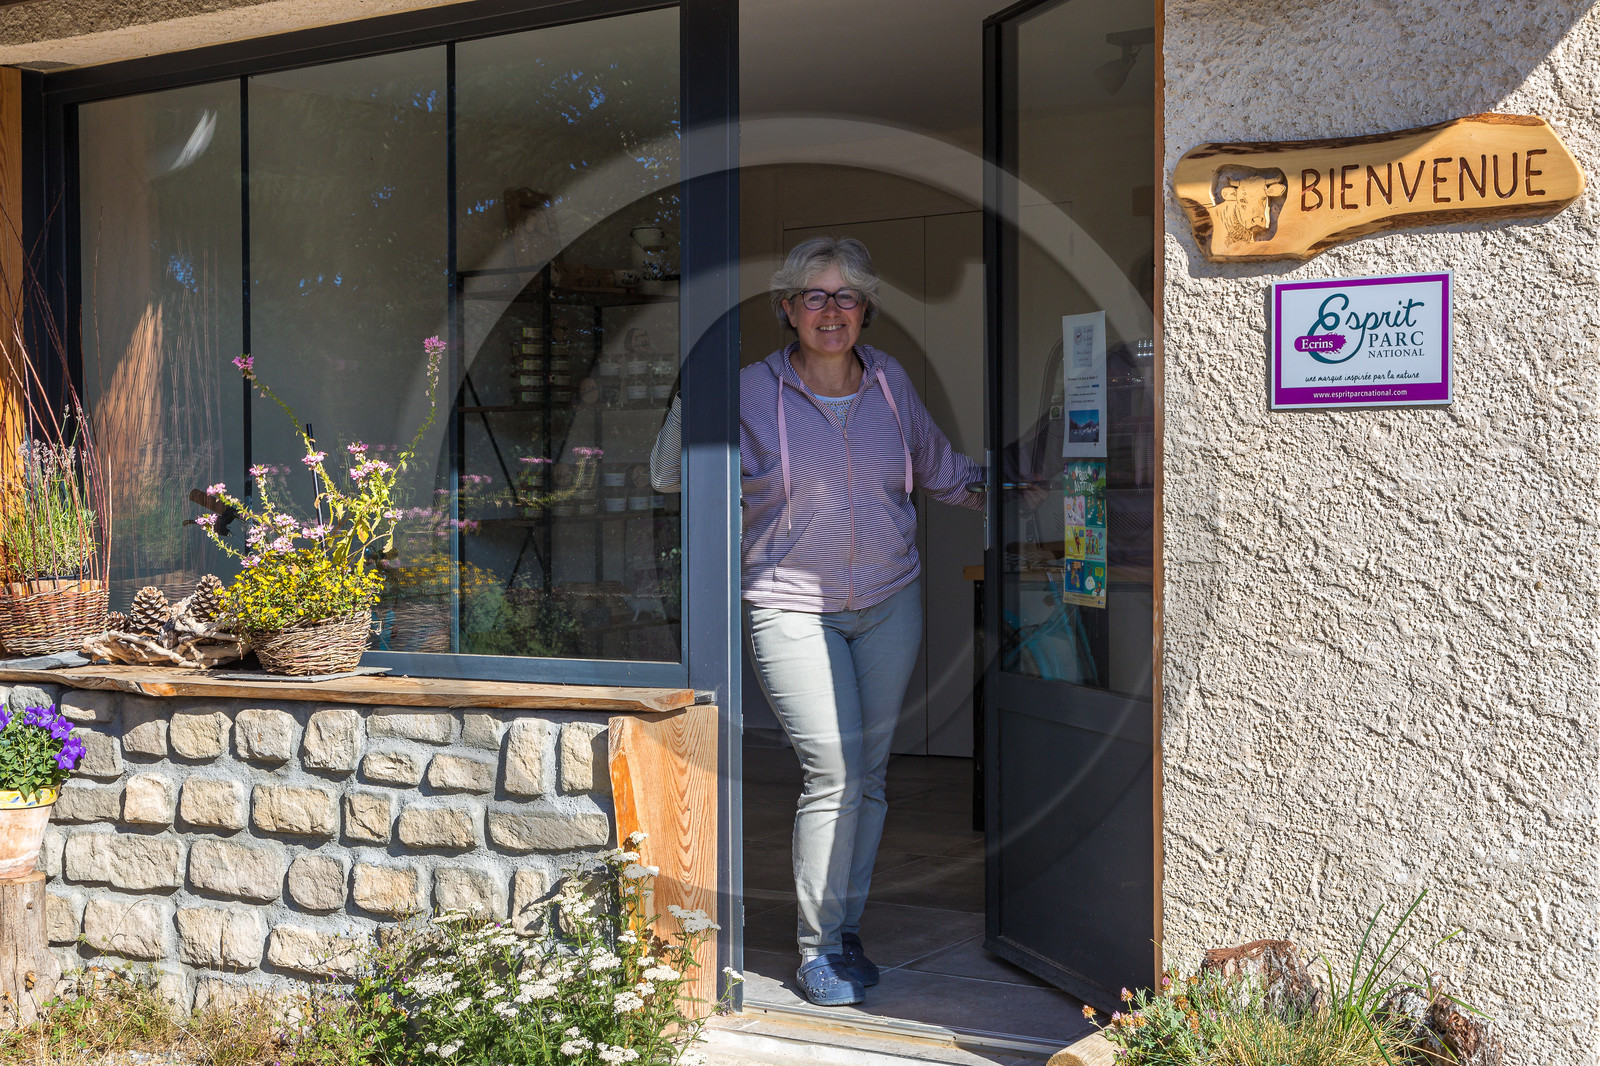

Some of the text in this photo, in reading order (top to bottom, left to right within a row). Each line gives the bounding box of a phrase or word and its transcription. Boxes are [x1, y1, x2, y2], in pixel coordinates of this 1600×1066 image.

[1301, 148, 1547, 212] BIENVENUE
[1307, 293, 1425, 364] Esprit
[1301, 338, 1334, 350] Ecrins
[1368, 331, 1424, 348] PARC
[1368, 348, 1425, 359] NATIONAL
[1317, 375, 1343, 383] marque
[1344, 372, 1372, 383] inspirée
[1373, 374, 1385, 382] par
[1387, 370, 1395, 379] la
[1396, 370, 1420, 379] nature
[1313, 389, 1408, 399] www.espritparcnational.com
